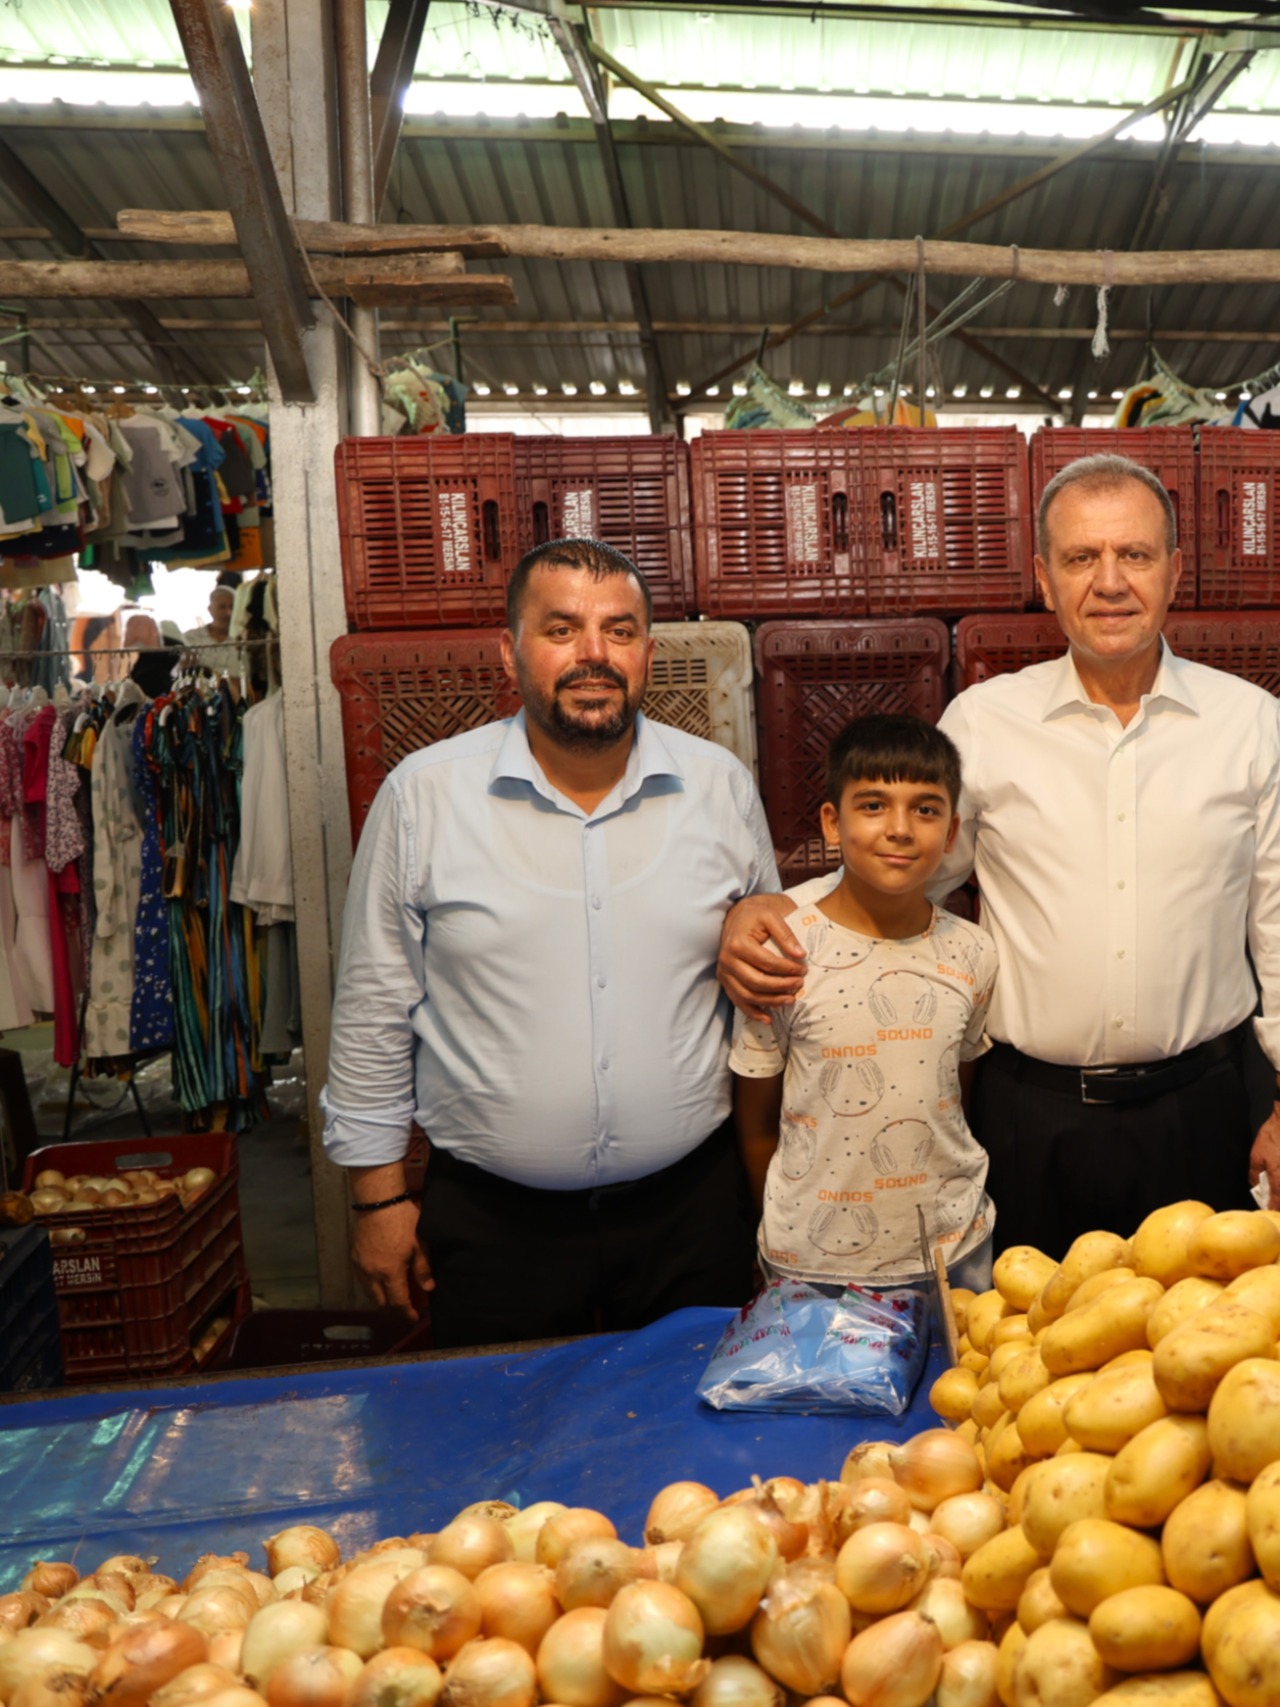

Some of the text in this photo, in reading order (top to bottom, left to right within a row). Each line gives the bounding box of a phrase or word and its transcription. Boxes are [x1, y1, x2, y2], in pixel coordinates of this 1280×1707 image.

[801, 485, 820, 561] KILINÇARSLAN
[910, 482, 927, 558] KILINÇARSLAN
[1242, 482, 1259, 555] KILINÇARSLAN
[453, 493, 471, 570] KILINÇARSLAN
[877, 1028, 933, 1041] SOUND
[821, 1044, 877, 1058] SOUND
[874, 1173, 928, 1190] SOUND
[818, 1189, 874, 1203] SOUND
[53, 1256, 100, 1275] ARSLAN
